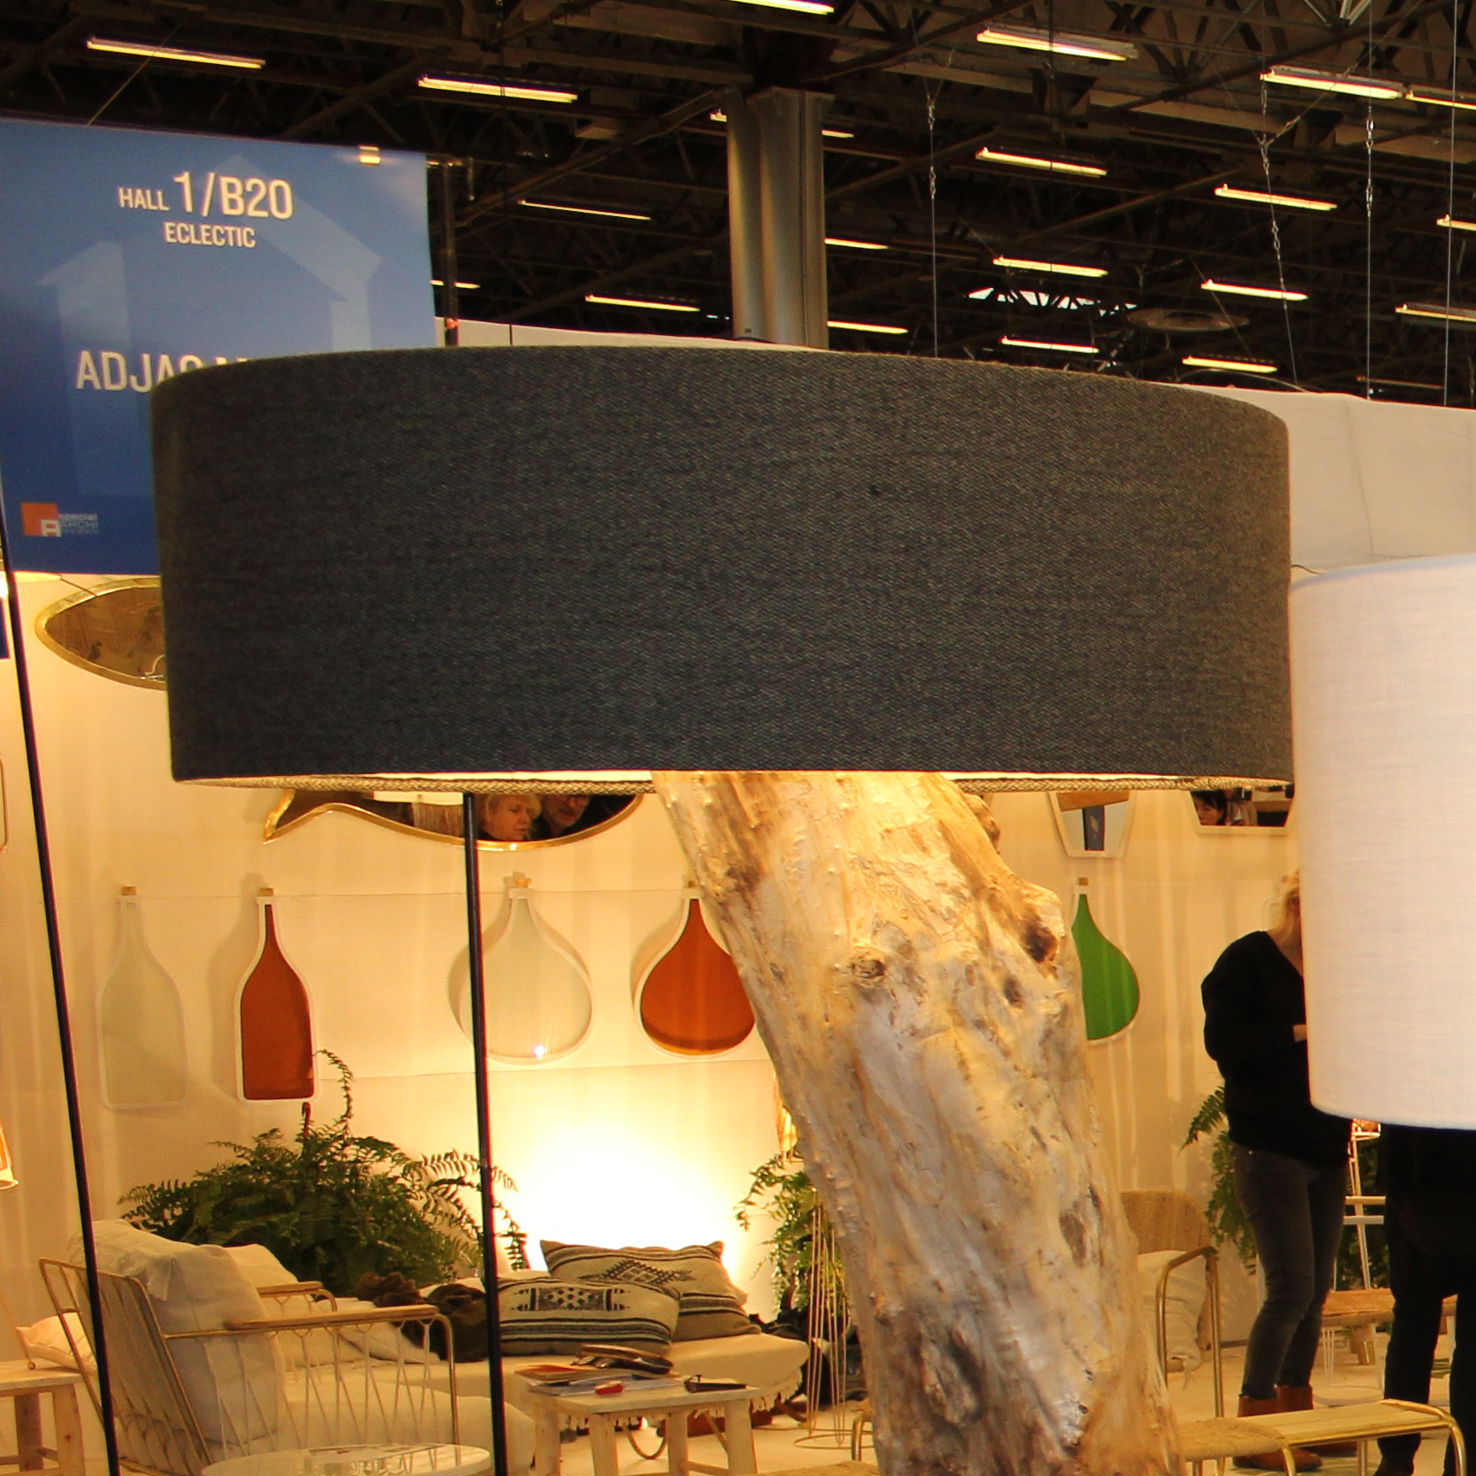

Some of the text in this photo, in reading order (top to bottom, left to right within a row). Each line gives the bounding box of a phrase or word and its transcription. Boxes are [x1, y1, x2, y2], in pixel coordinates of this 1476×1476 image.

[118, 170, 294, 220] HALL 1/B20
[163, 221, 257, 248] ECLECTIC
